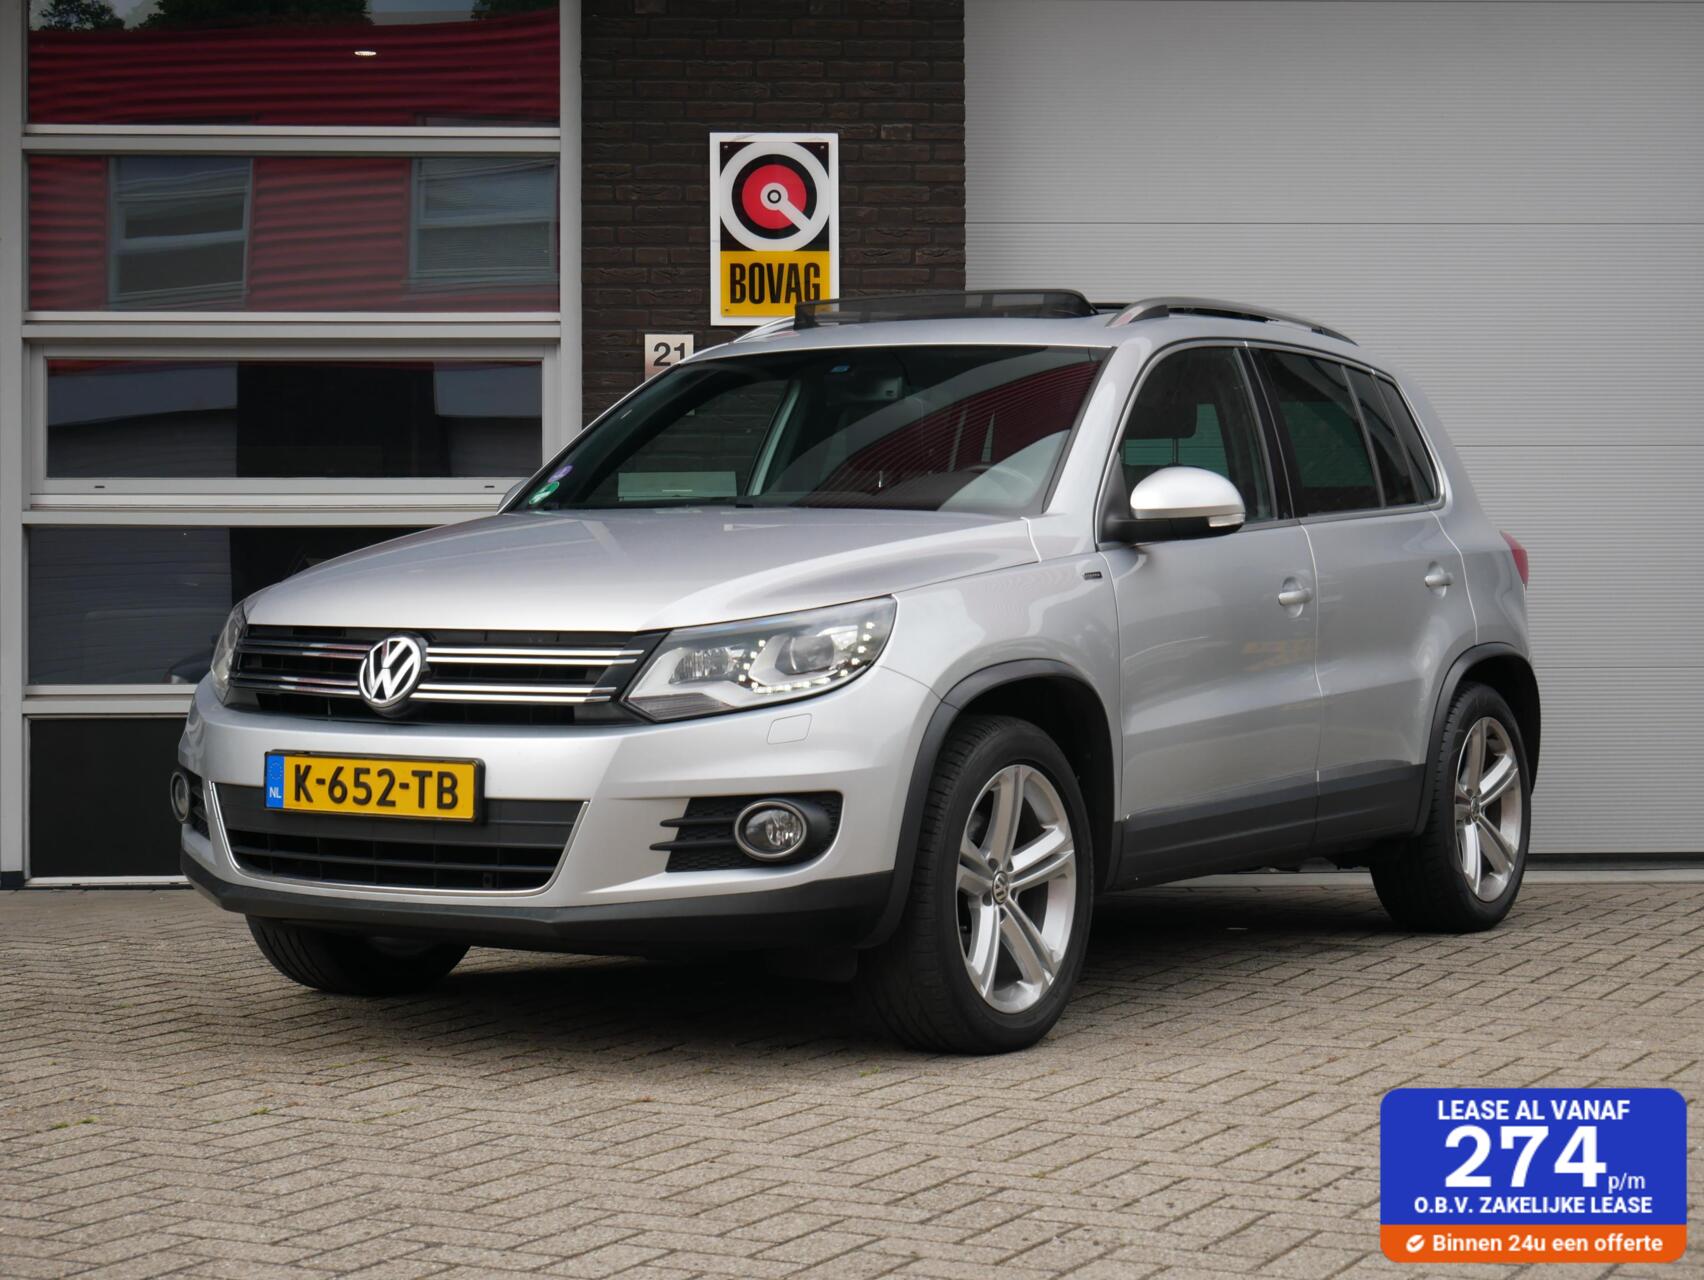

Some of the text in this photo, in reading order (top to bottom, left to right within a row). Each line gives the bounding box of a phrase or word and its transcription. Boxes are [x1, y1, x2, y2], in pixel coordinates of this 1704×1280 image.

[729, 262, 821, 305] BOVAG
[653, 342, 685, 367] 21
[269, 786, 282, 799] NL
[294, 764, 459, 810] K-652-TB
